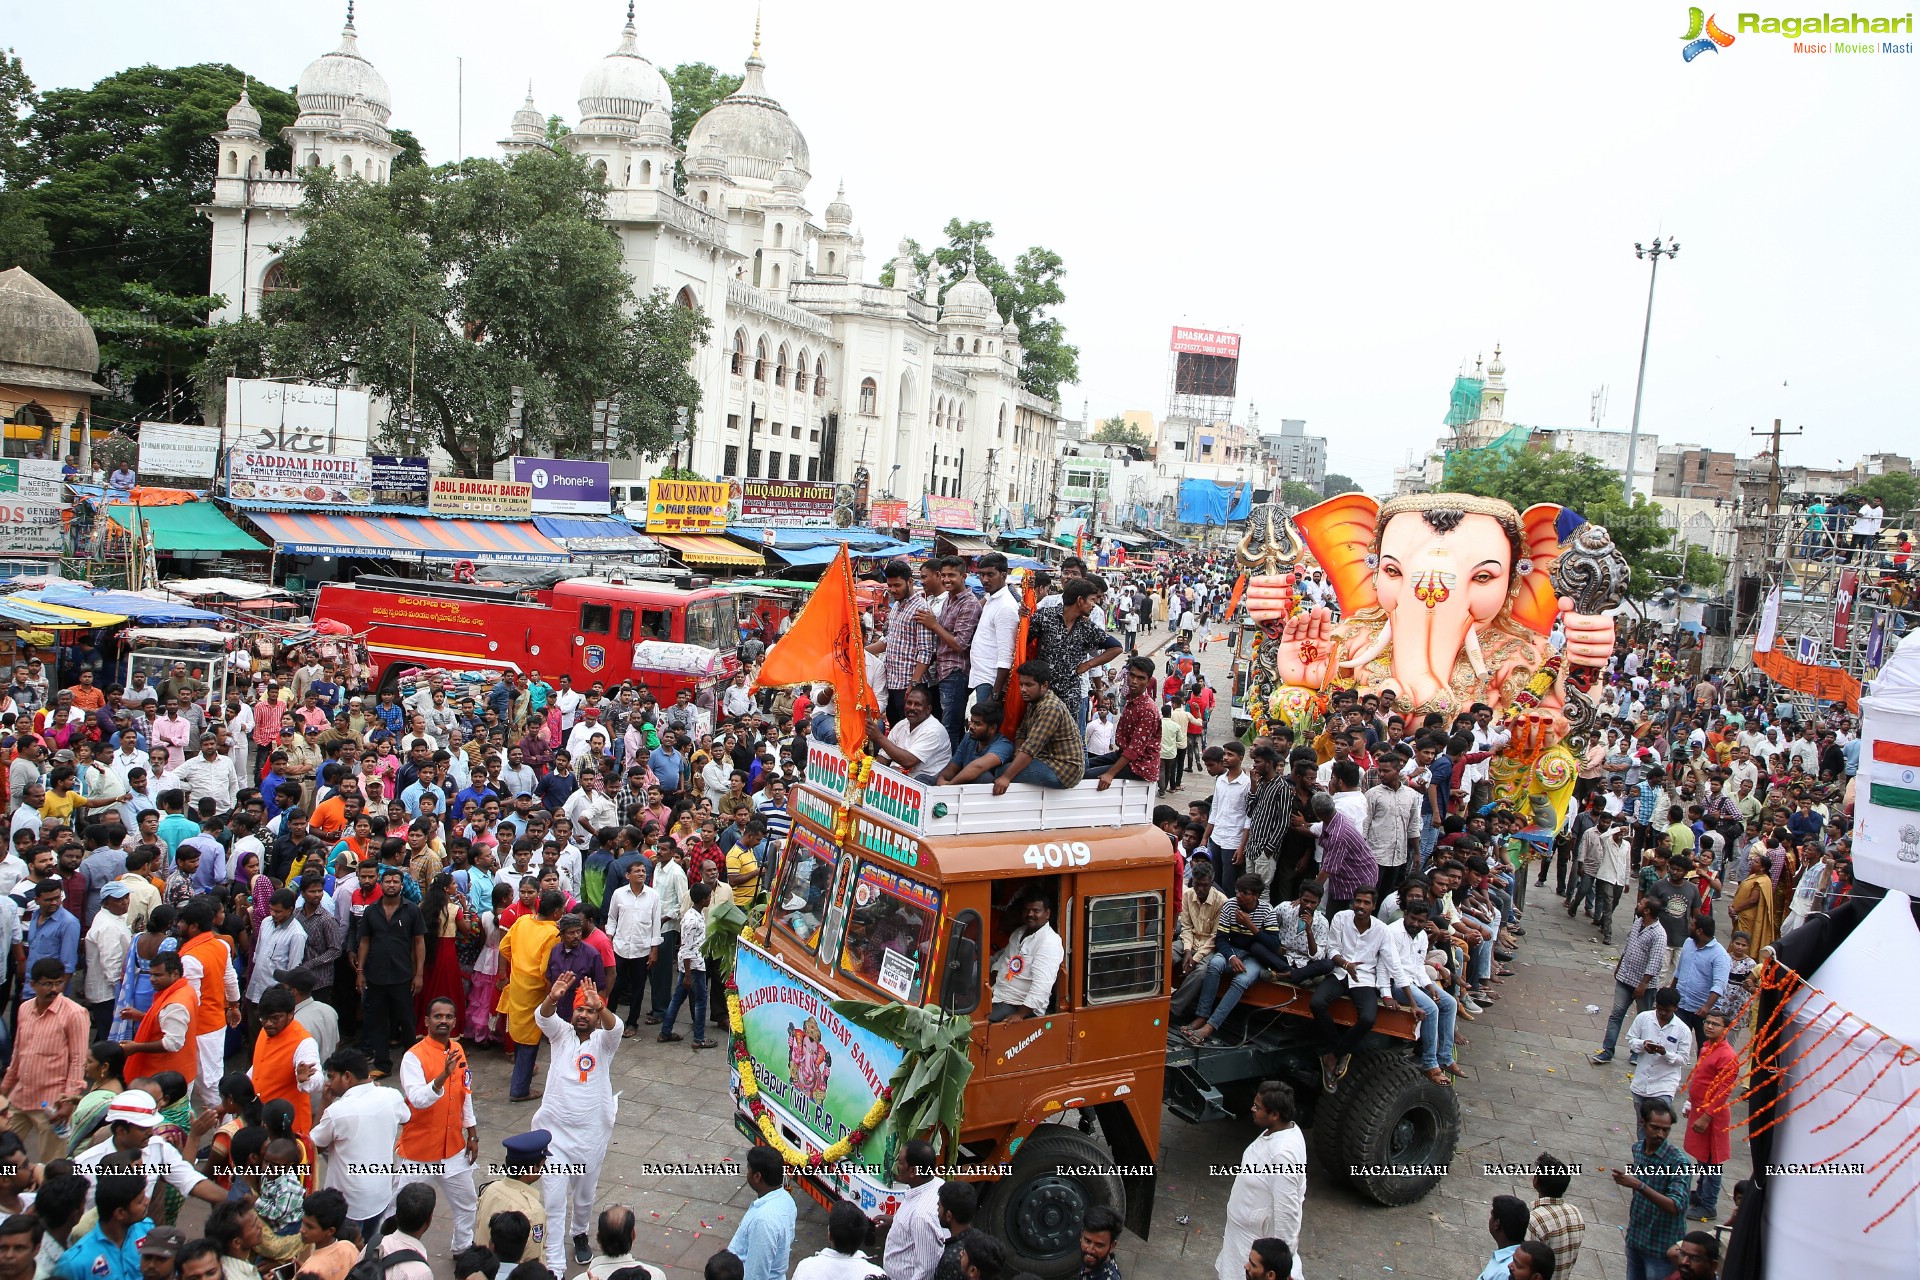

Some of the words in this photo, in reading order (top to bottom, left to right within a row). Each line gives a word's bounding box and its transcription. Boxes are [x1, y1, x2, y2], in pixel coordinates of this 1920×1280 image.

[1176, 330, 1215, 343] BHASKAR
[1215, 334, 1237, 346] ARTS
[246, 454, 307, 470] SADDAM
[312, 458, 358, 474] HOTEL
[250, 467, 274, 476] FAMILY
[275, 469, 301, 478] SECTION
[303, 470, 319, 479] ALSO
[320, 472, 355, 481] AVAILABLE
[552, 474, 594, 487] PhonePe
[433, 480, 457, 493] ABUL
[459, 482, 498, 496] BARKAAT
[500, 484, 531, 498] BAKERY
[657, 482, 724, 503] MUNNU
[744, 483, 802, 500] MUQADDAR
[802, 486, 834, 500] HOTEL
[665, 503, 686, 515] PAN
[687, 504, 714, 517] SHOP
[295, 545, 318, 553] SADDAM
[318, 546, 336, 554] HOTEL
[354, 548, 377, 556] SECTION
[477, 553, 495, 561] ABUL
[526, 555, 551, 563] BAKERY
[808, 748, 848, 794] GOODS
[865, 769, 922, 828] CARRIER
[858, 818, 919, 868] TRAILERS
[1022, 841, 1092, 870] 4019
[739, 987, 780, 1016] BALAPUR
[780, 986, 818, 1017] GANESH
[818, 1006, 852, 1048] UTSAV
[850, 1042, 886, 1098] SAMIT
[1004, 1027, 1044, 1060] Welcome
